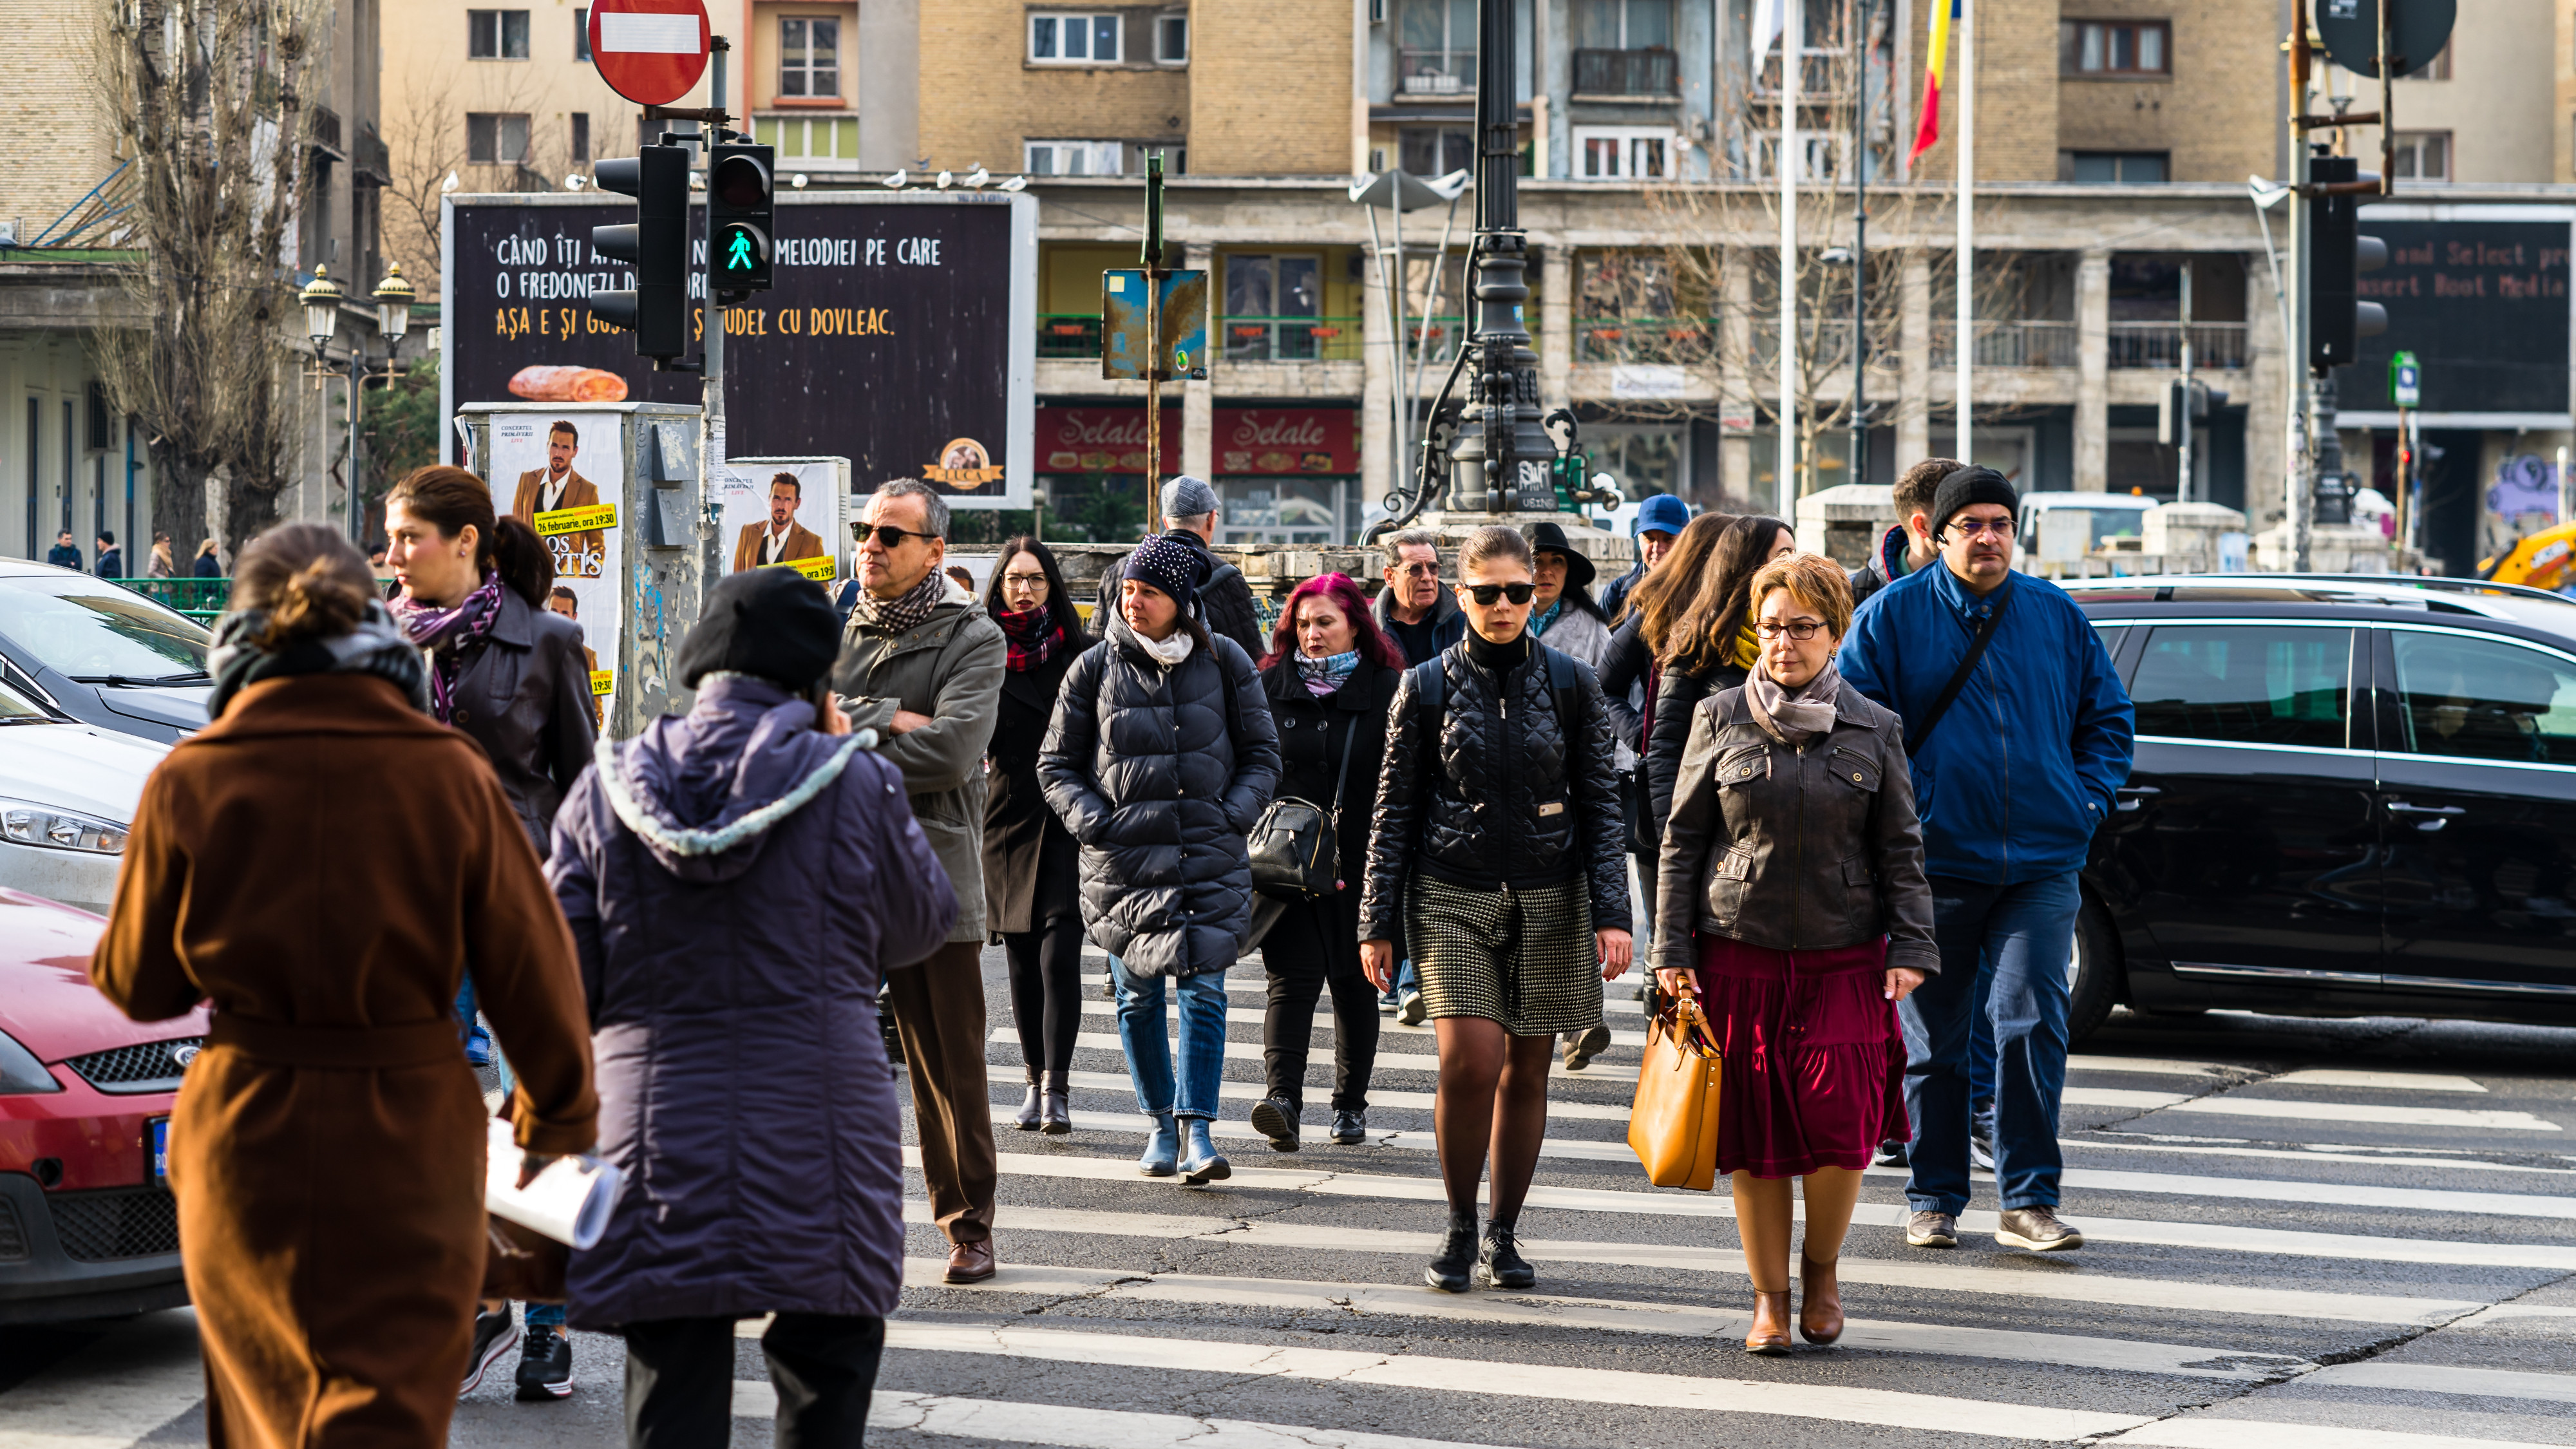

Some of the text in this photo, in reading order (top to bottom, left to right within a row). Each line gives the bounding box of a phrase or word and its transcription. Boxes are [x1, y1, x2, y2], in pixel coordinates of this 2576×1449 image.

[497, 233, 547, 266] CÂND
[775, 237, 942, 266] MELODIEI PE CARE
[2448, 241, 2524, 266] Select
[497, 272, 509, 298] O
[2356, 274, 2420, 298] nsert
[2434, 273, 2485, 298] Boot
[540, 309, 549, 334] E
[694, 307, 895, 341] ȘUDEL CU DOVLEAC.
[1057, 410, 1148, 445] Selale
[1232, 410, 1325, 446] Selale
[945, 469, 982, 480] LUCA
[538, 522, 547, 532] 26
[548, 519, 582, 531] februarie,
[595, 513, 614, 525] 19:30
[546, 536, 570, 553] OS
[552, 553, 602, 576] RTIS
[594, 680, 612, 691] 19:30
[155, 1153, 167, 1169] RO
